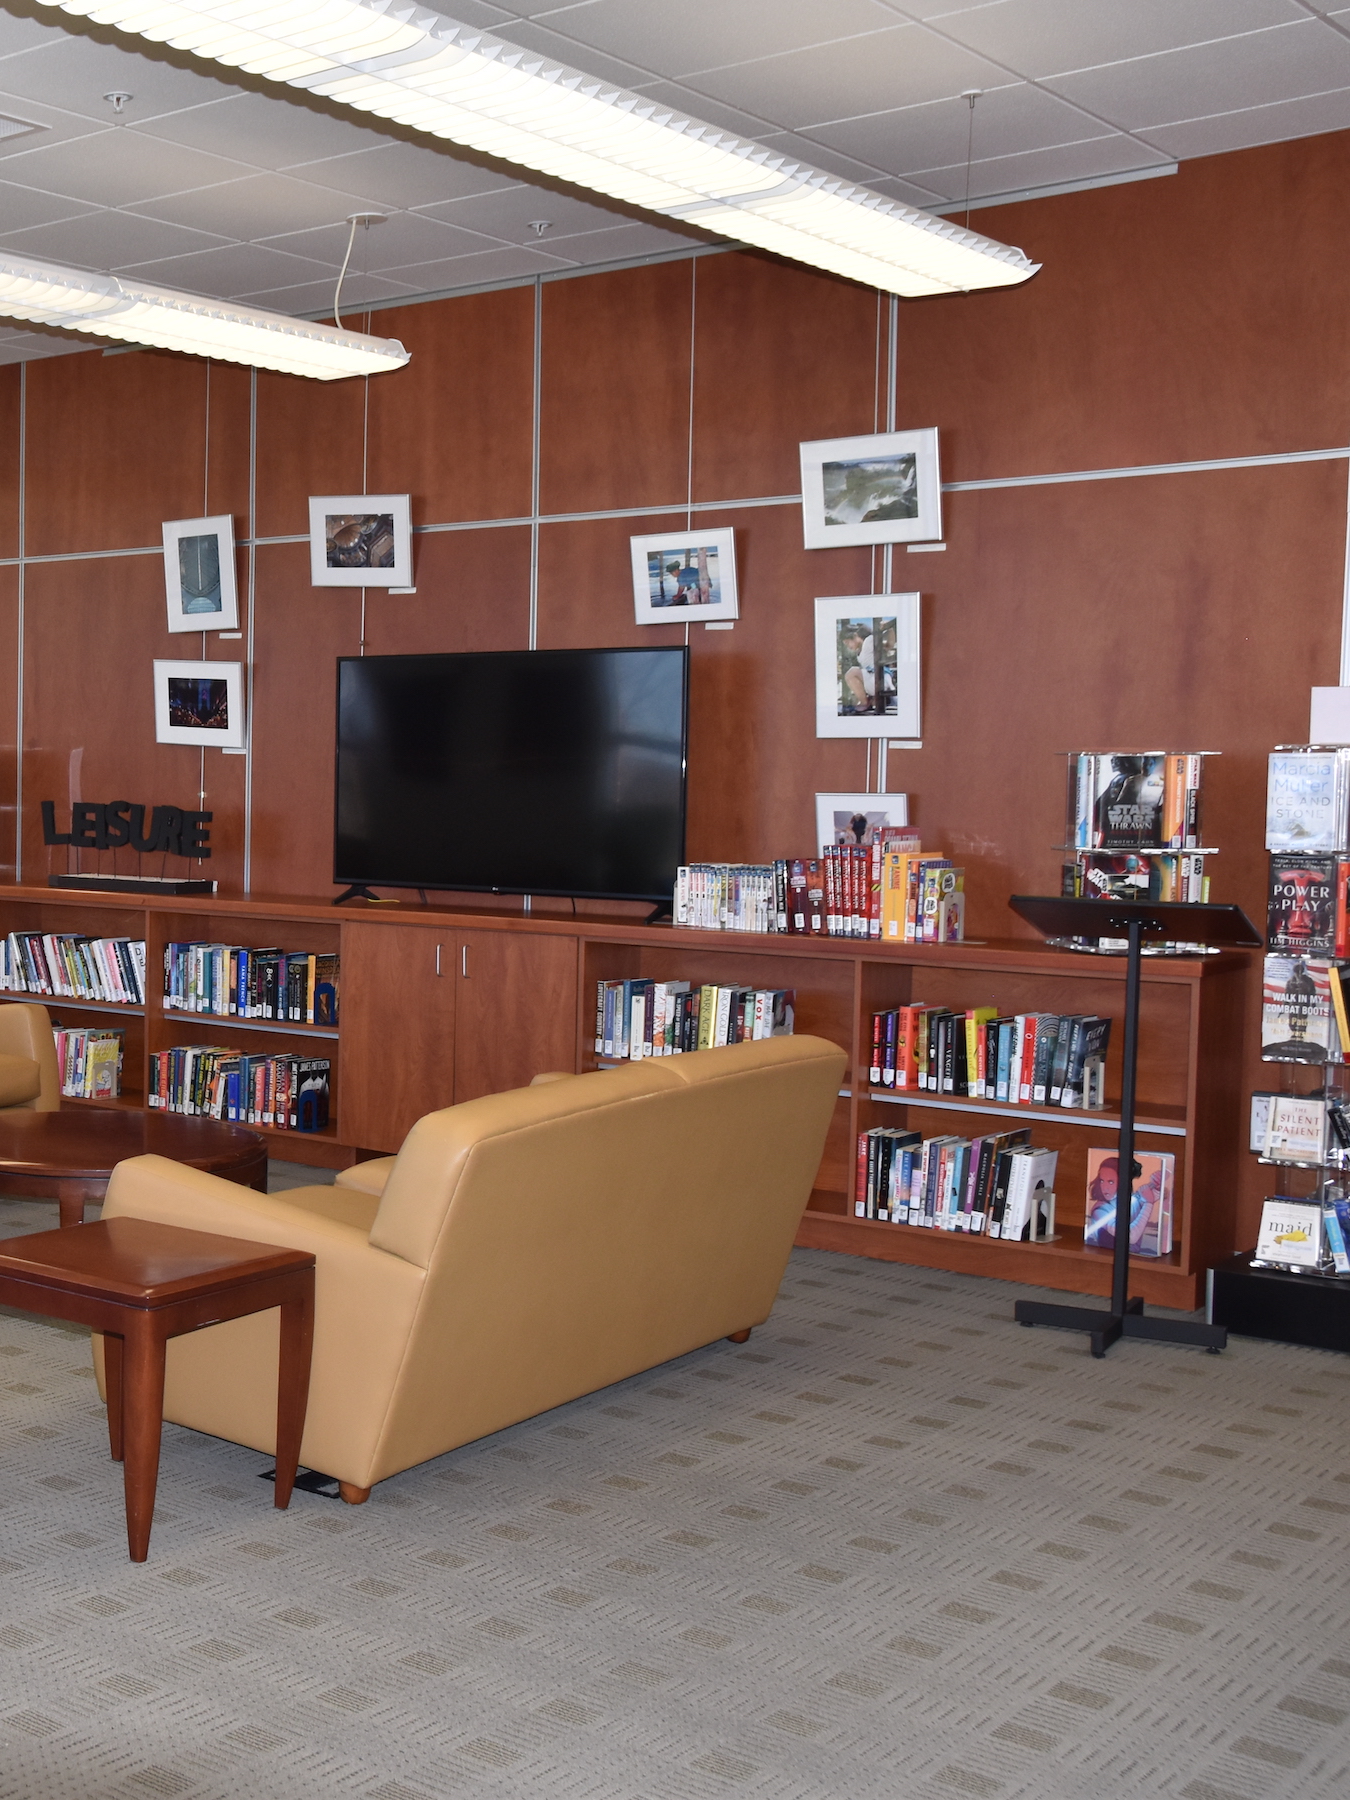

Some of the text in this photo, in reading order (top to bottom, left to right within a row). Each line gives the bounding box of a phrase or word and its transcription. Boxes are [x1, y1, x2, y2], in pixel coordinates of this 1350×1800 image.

[1272, 762, 1331, 775] Marcia
[1274, 779, 1328, 792] Muler
[1270, 796, 1330, 806] ICE AND
[1108, 804, 1155, 816] STAR
[1276, 809, 1324, 819] STONE
[1108, 814, 1155, 824] WARS
[41, 800, 213, 858] LEISURE
[1110, 822, 1153, 830] THRAWN
[1274, 885, 1330, 898] POWER
[1281, 899, 1320, 911] PLAY
[1288, 939, 1330, 947] HIGGINS
[1272, 993, 1324, 1003] WALK IN MY
[701, 989, 711, 1034] DARK AGE
[719, 991, 729, 1036] IRON GOLD
[1266, 1004, 1330, 1016] COMBAT BOOTS
[1086, 1024, 1106, 1041] EVERY
[1280, 1114, 1319, 1125] SILENT
[1277, 1125, 1321, 1137] PATIENT
[980, 1153, 988, 1179] MAGNOLIA
[1269, 1221, 1312, 1237] maid
